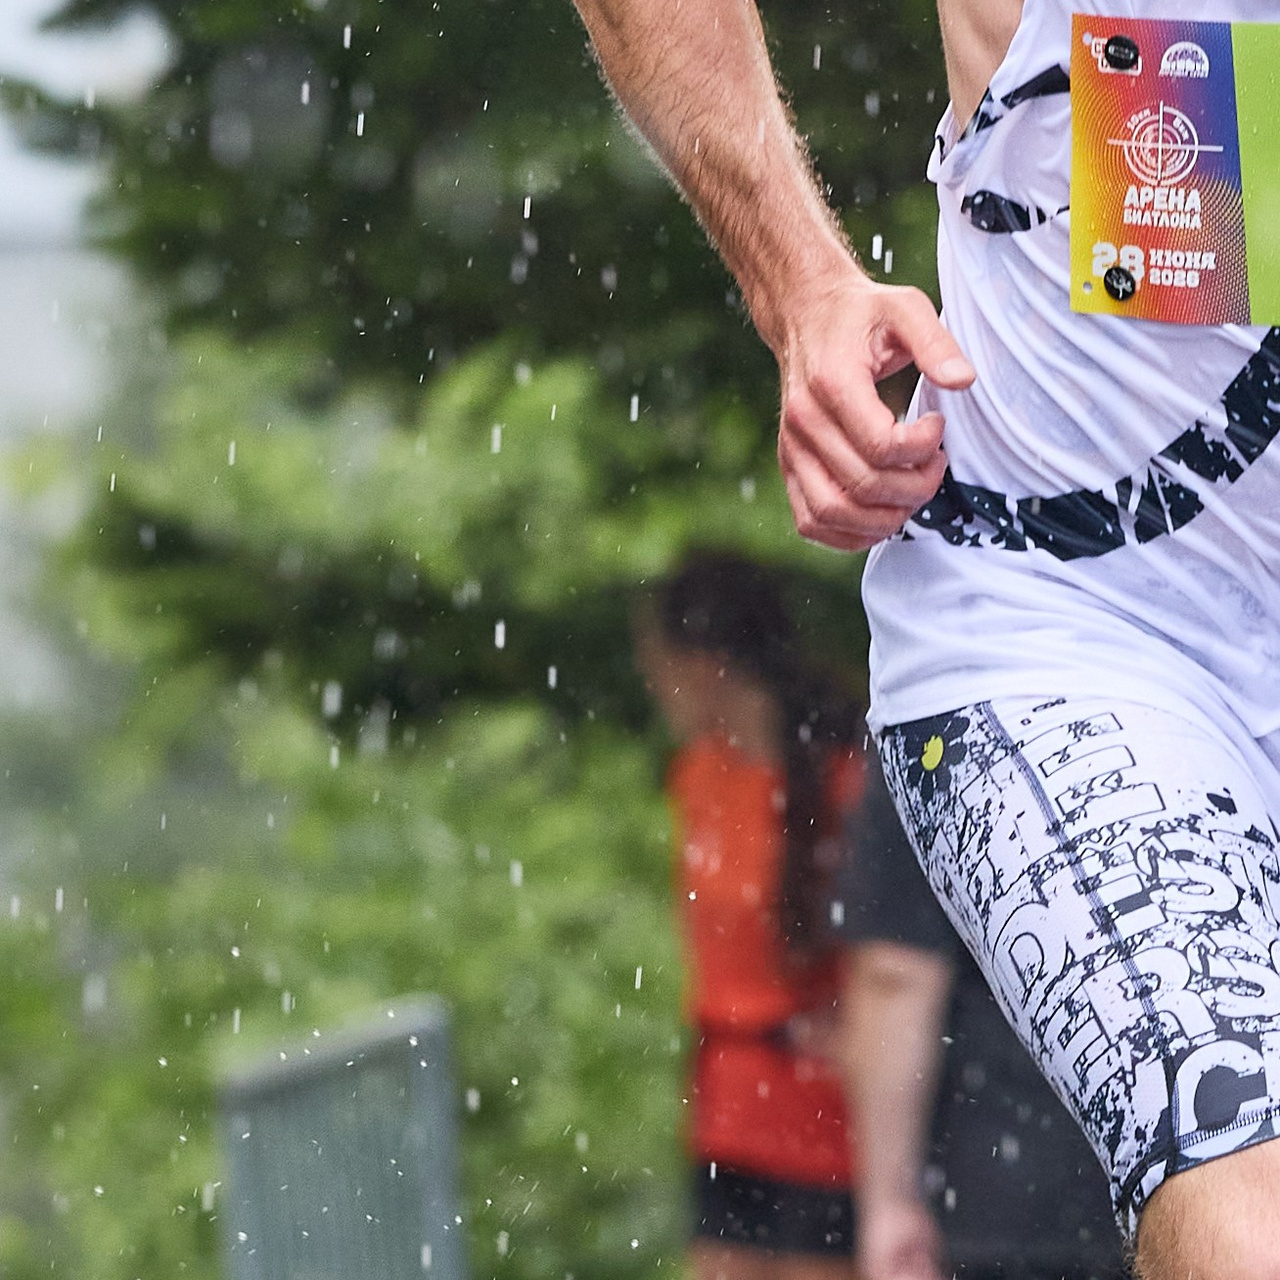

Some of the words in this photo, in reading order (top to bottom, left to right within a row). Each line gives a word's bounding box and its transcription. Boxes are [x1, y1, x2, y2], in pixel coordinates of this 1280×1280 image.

[1124, 185, 1201, 214] АРЕНА
[1123, 208, 1201, 230] БИАТЛОНА
[1092, 241, 1145, 290] 28
[1149, 248, 1216, 270] ИЮНЯ
